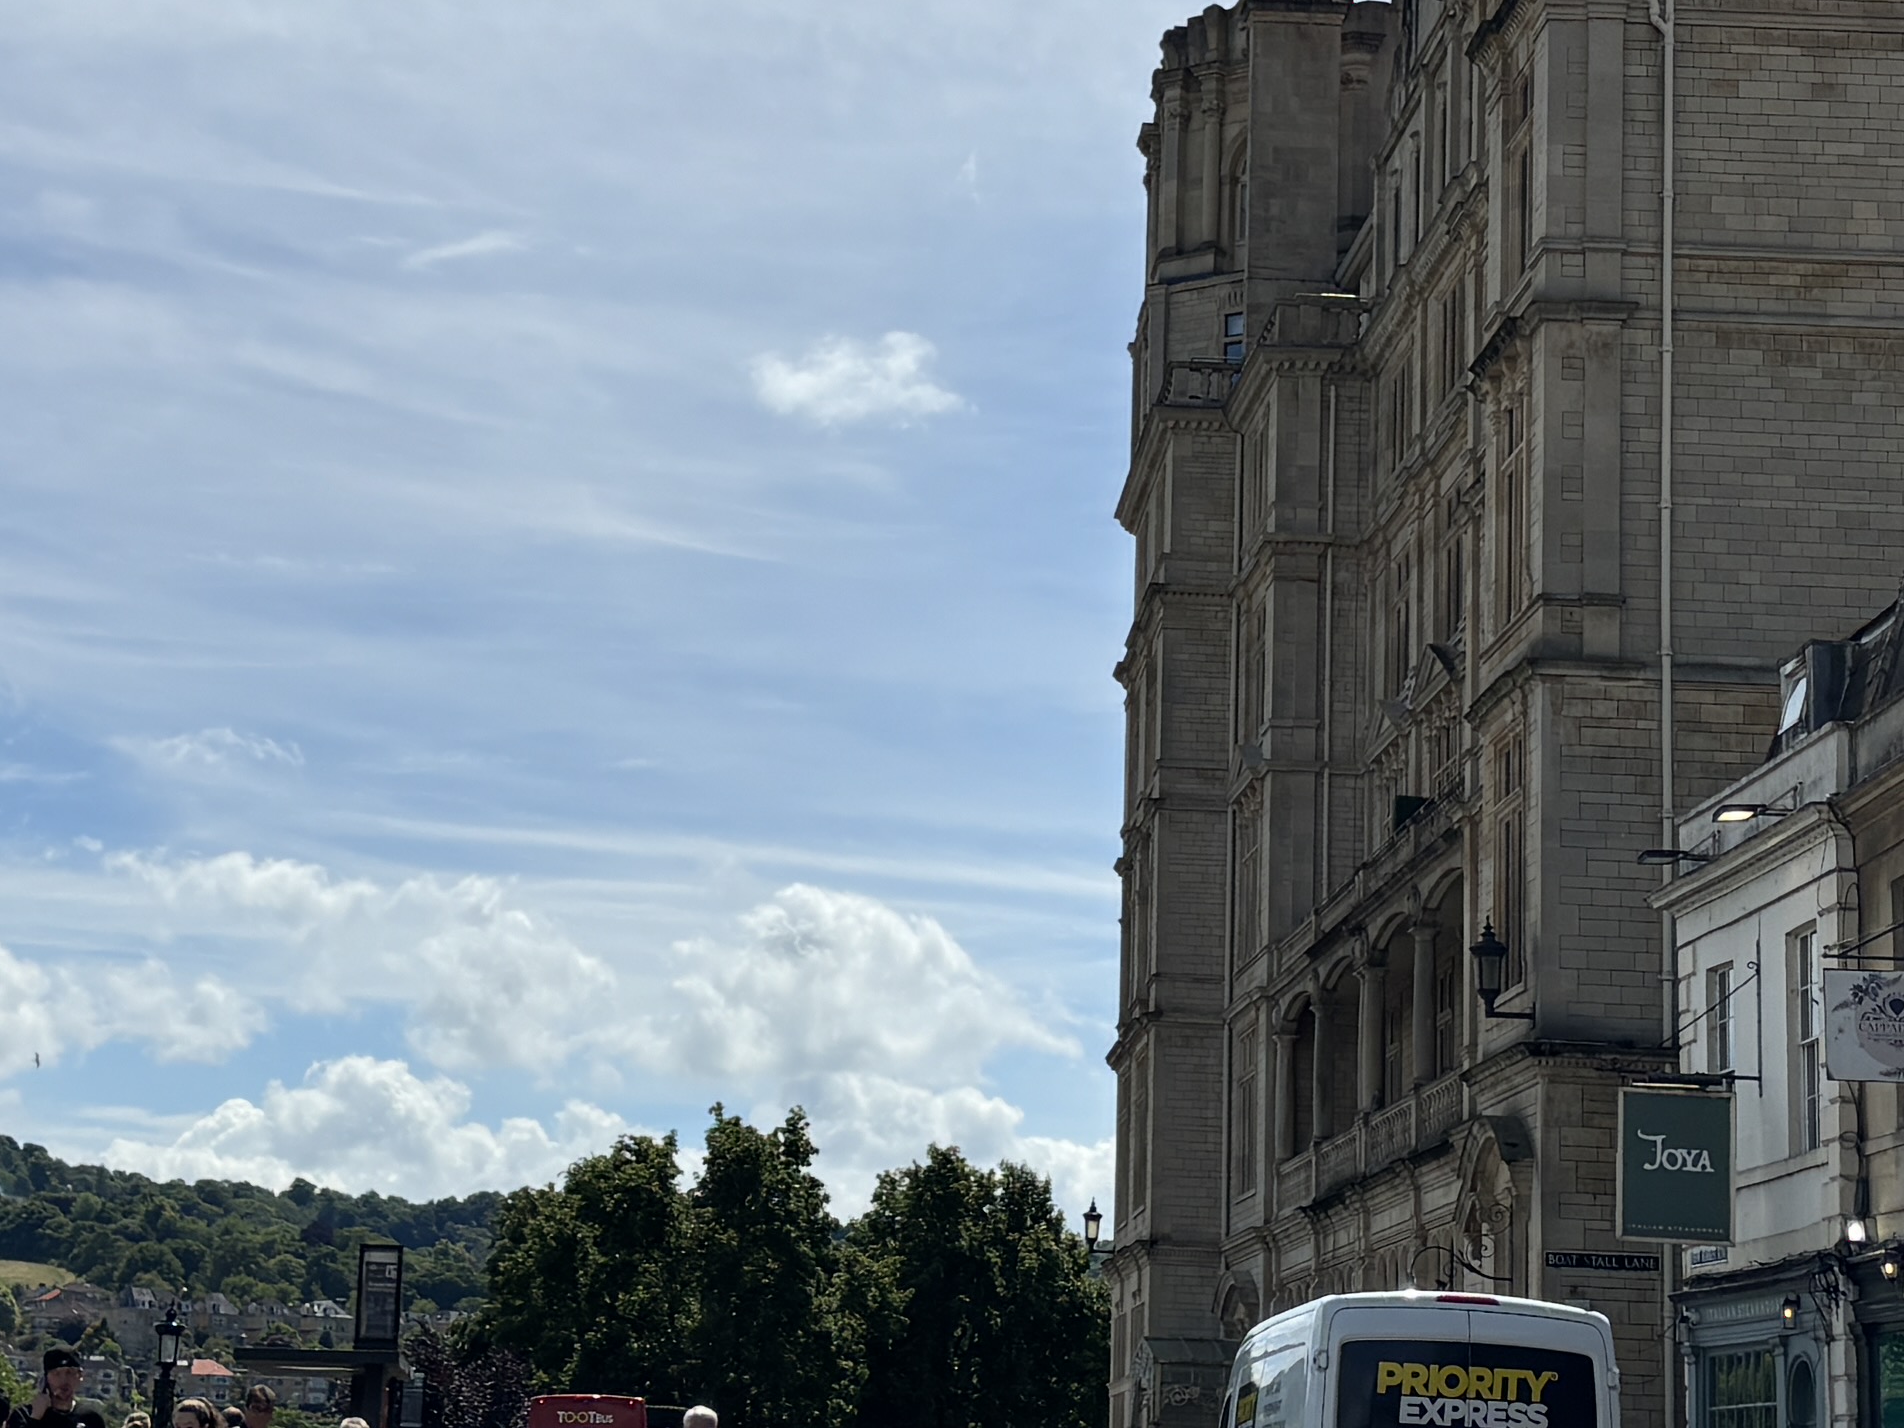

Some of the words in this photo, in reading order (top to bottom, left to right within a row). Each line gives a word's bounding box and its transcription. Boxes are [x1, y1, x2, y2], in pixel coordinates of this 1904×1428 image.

[1637, 1128, 1715, 1172] JOYA
[1548, 1253, 1577, 1266] BOAT
[1624, 1257, 1657, 1270] LANE
[1377, 1361, 1553, 1403] PRIORITY
